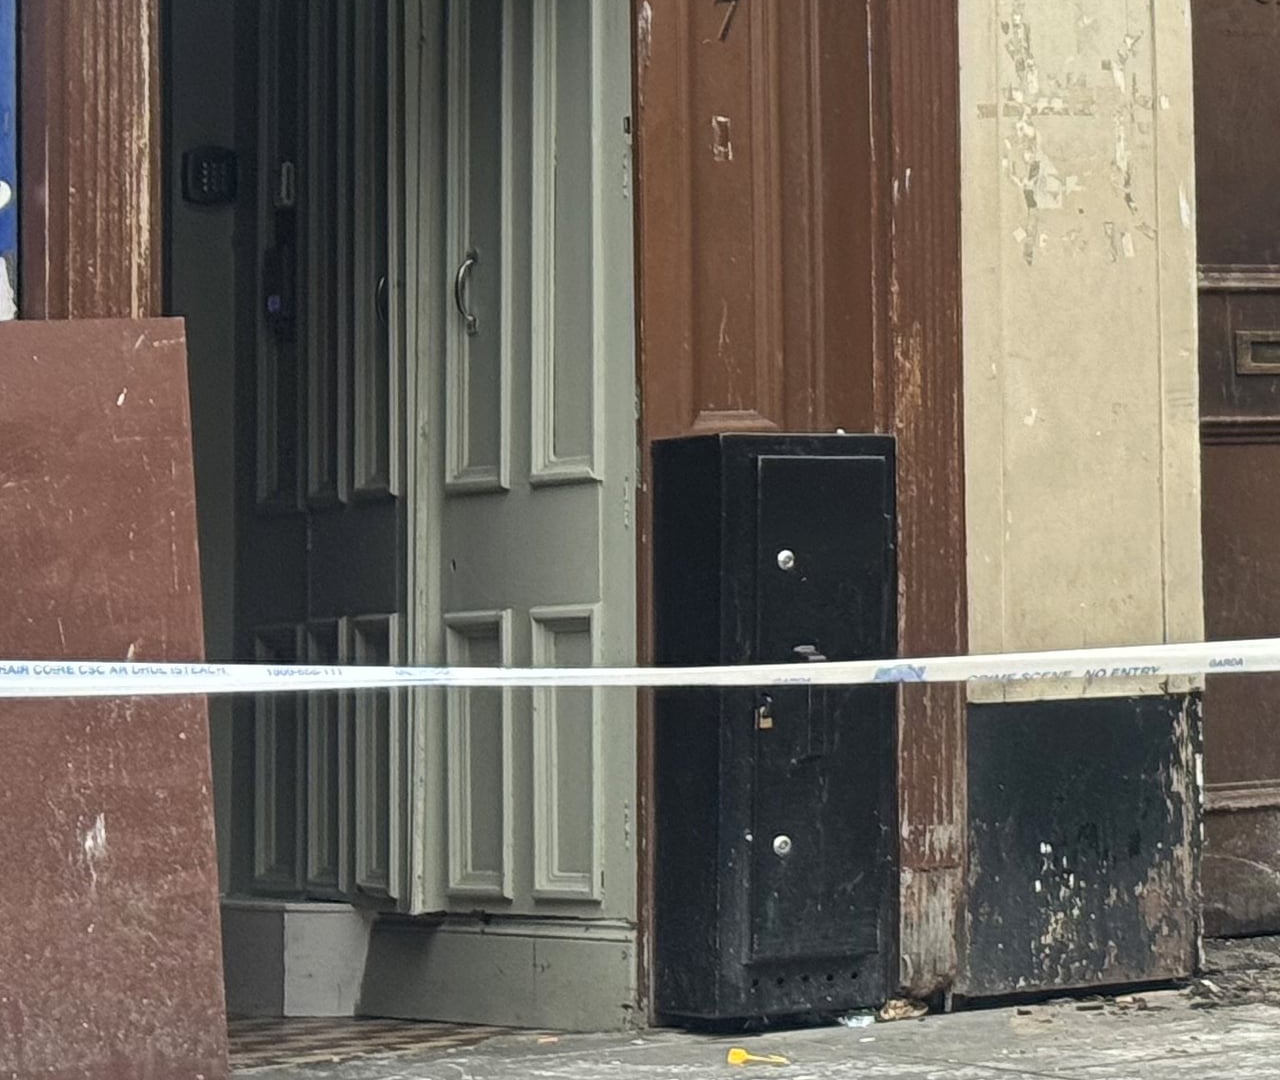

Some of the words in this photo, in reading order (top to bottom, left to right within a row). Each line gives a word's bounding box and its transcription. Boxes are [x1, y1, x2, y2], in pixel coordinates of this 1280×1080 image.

[1209, 657, 1244, 668] GARDA
[1084, 668, 1106, 679] NO
[1110, 666, 1161, 677] ENTRY
